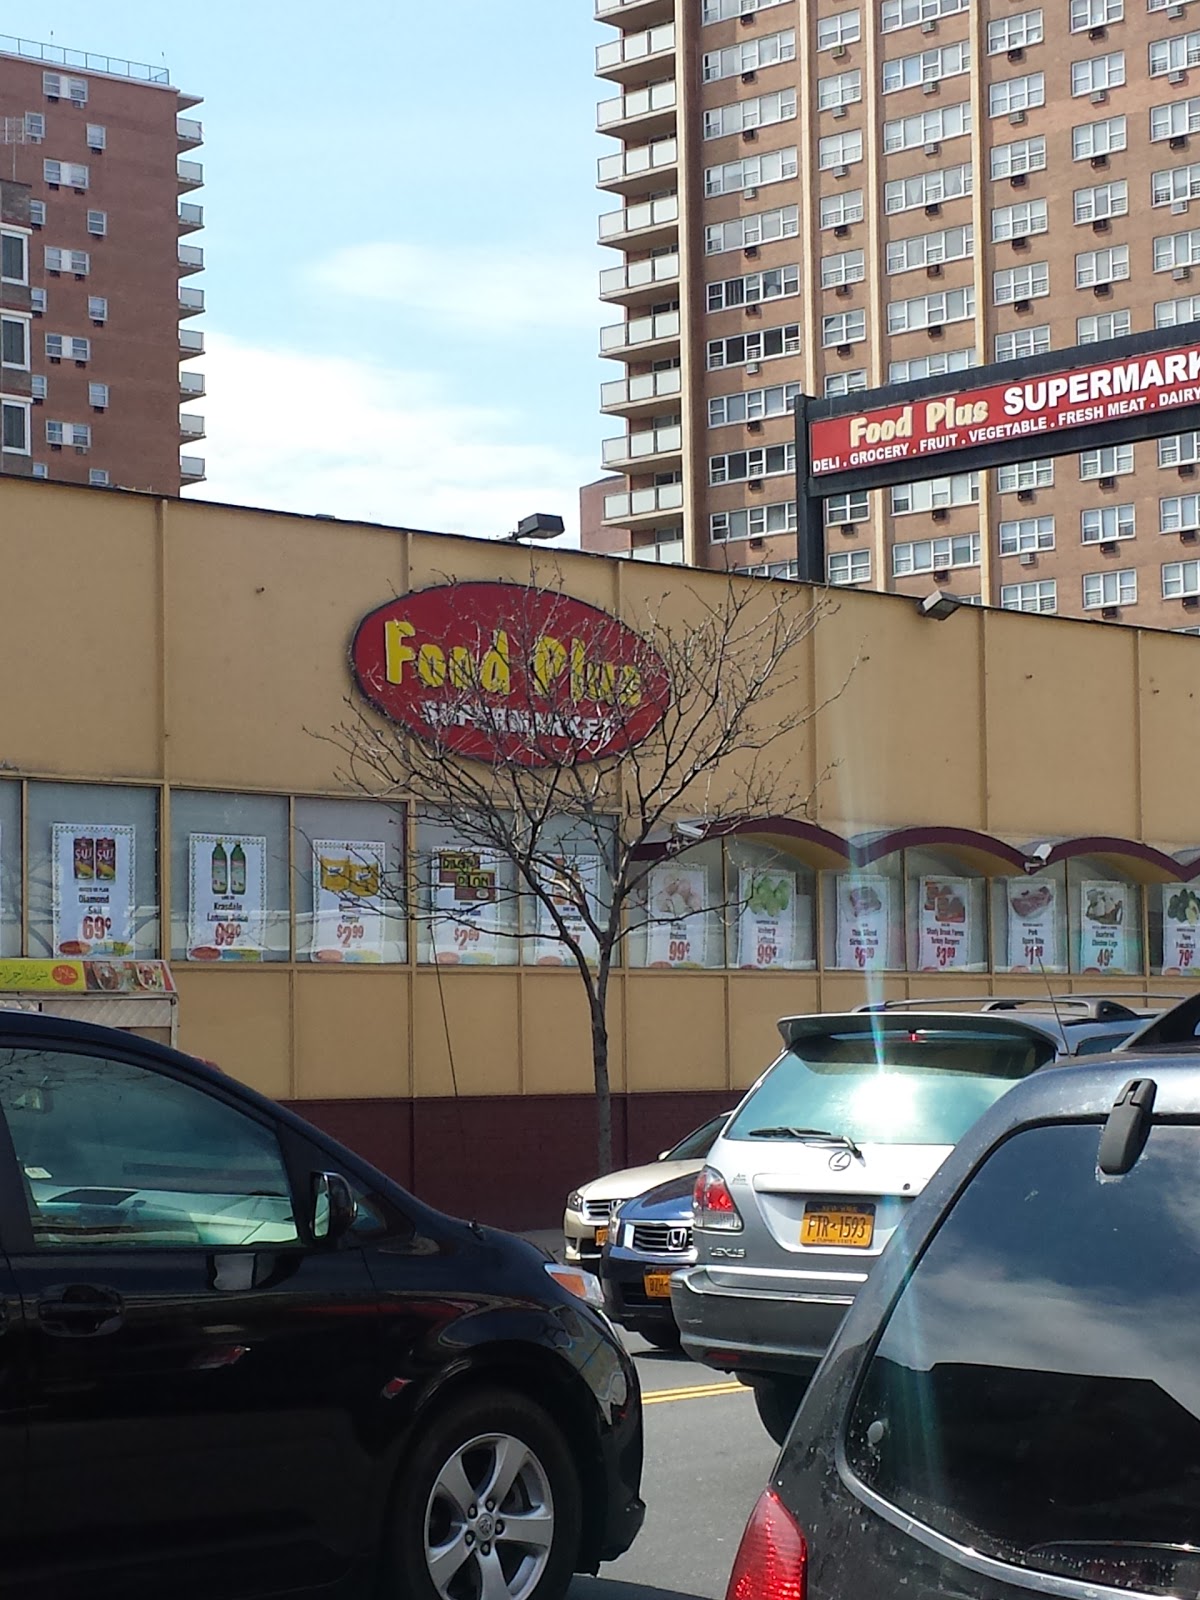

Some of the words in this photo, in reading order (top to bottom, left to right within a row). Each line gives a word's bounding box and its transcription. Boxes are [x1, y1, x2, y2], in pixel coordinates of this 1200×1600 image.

[813, 456, 840, 472] DELI
[850, 443, 909, 465] GROCERY
[920, 434, 958, 453] FRUIT
[969, 417, 1047, 443] VEGETABLE
[1058, 406, 1104, 426] FRESH
[1108, 397, 1147, 416] MEAT
[850, 407, 913, 447] Food
[926, 398, 988, 433] Plus
[385, 620, 510, 696] Food
[533, 635, 642, 707] Plus
[79, 894, 109, 903] Diamond
